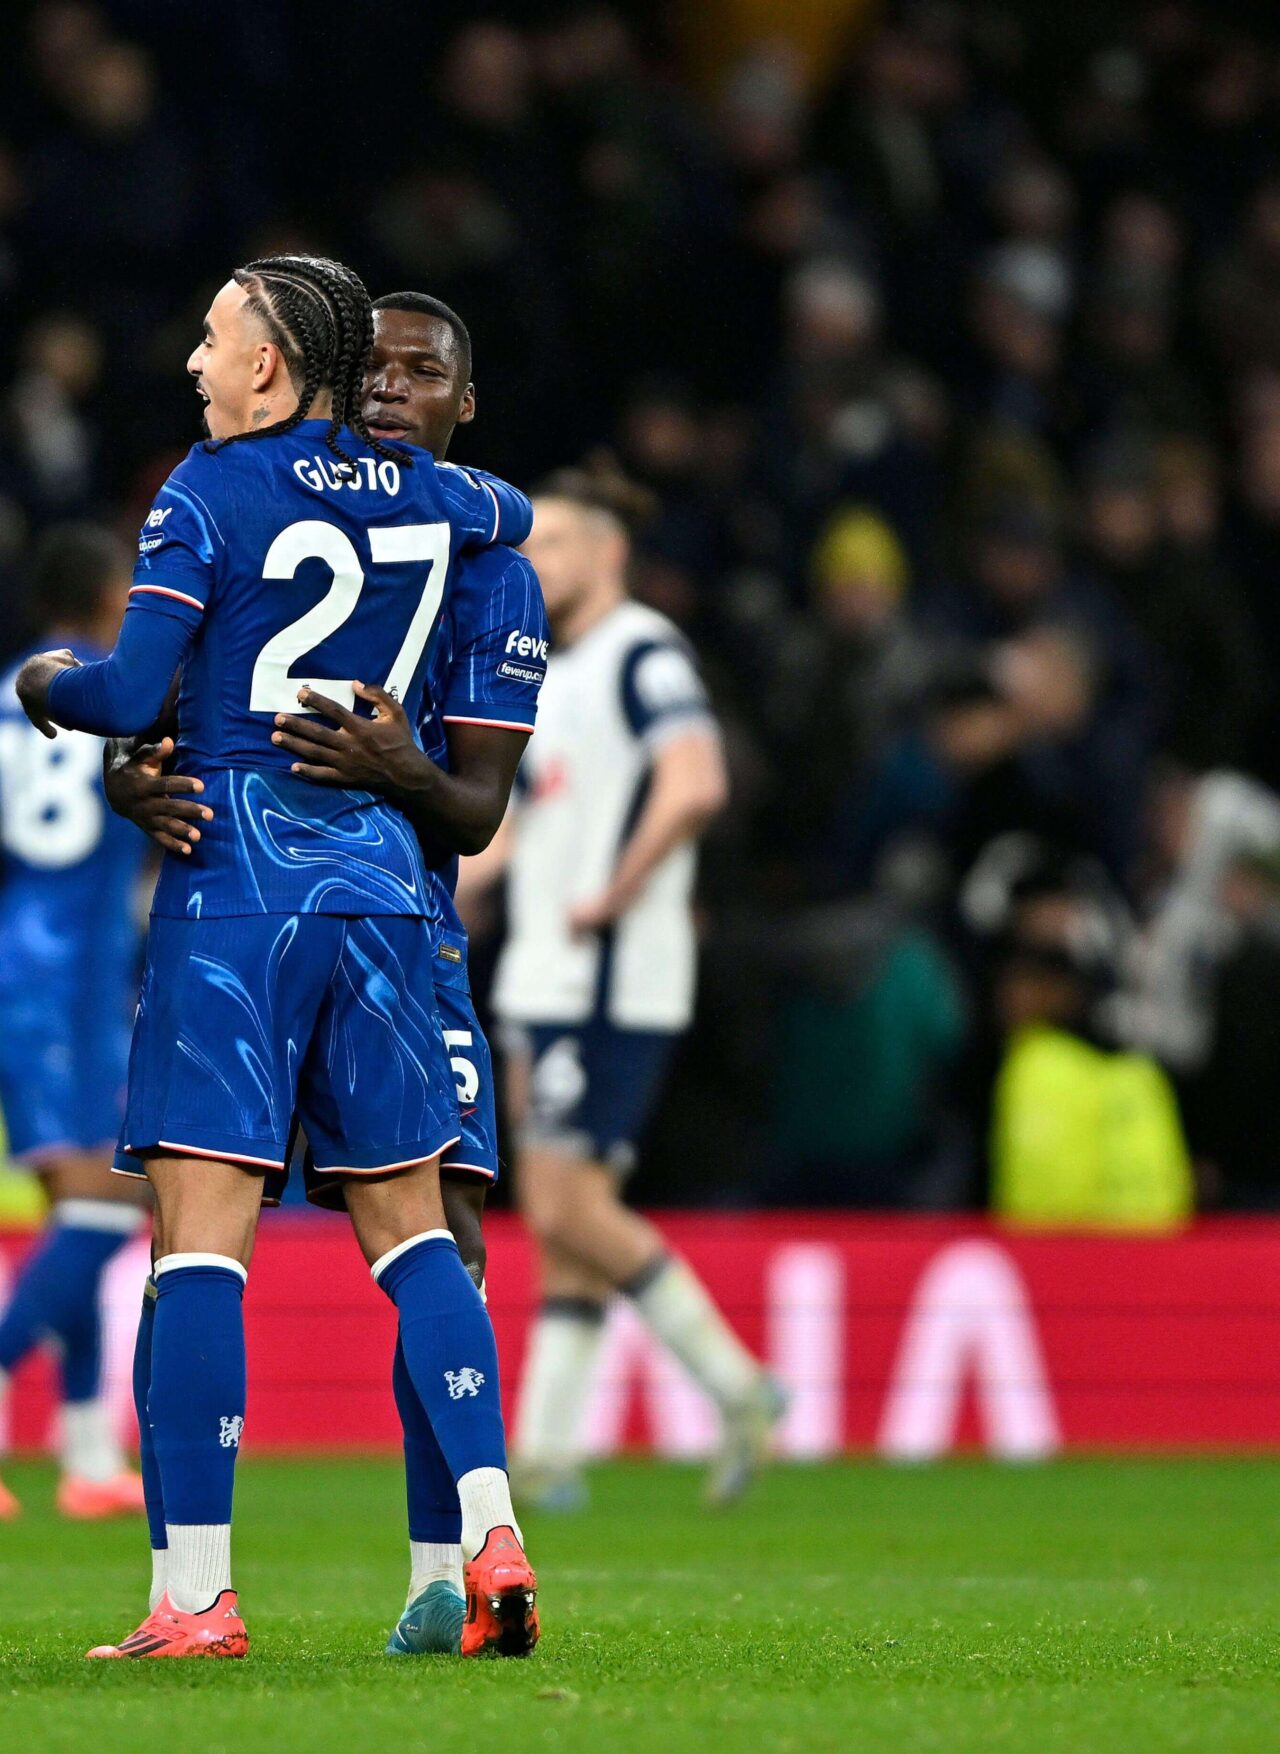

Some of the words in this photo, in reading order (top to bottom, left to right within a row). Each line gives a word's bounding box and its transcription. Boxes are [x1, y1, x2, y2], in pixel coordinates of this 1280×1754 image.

[293, 456, 400, 496] GUSTO
[249, 520, 451, 713] 27
[504, 630, 549, 661] feve
